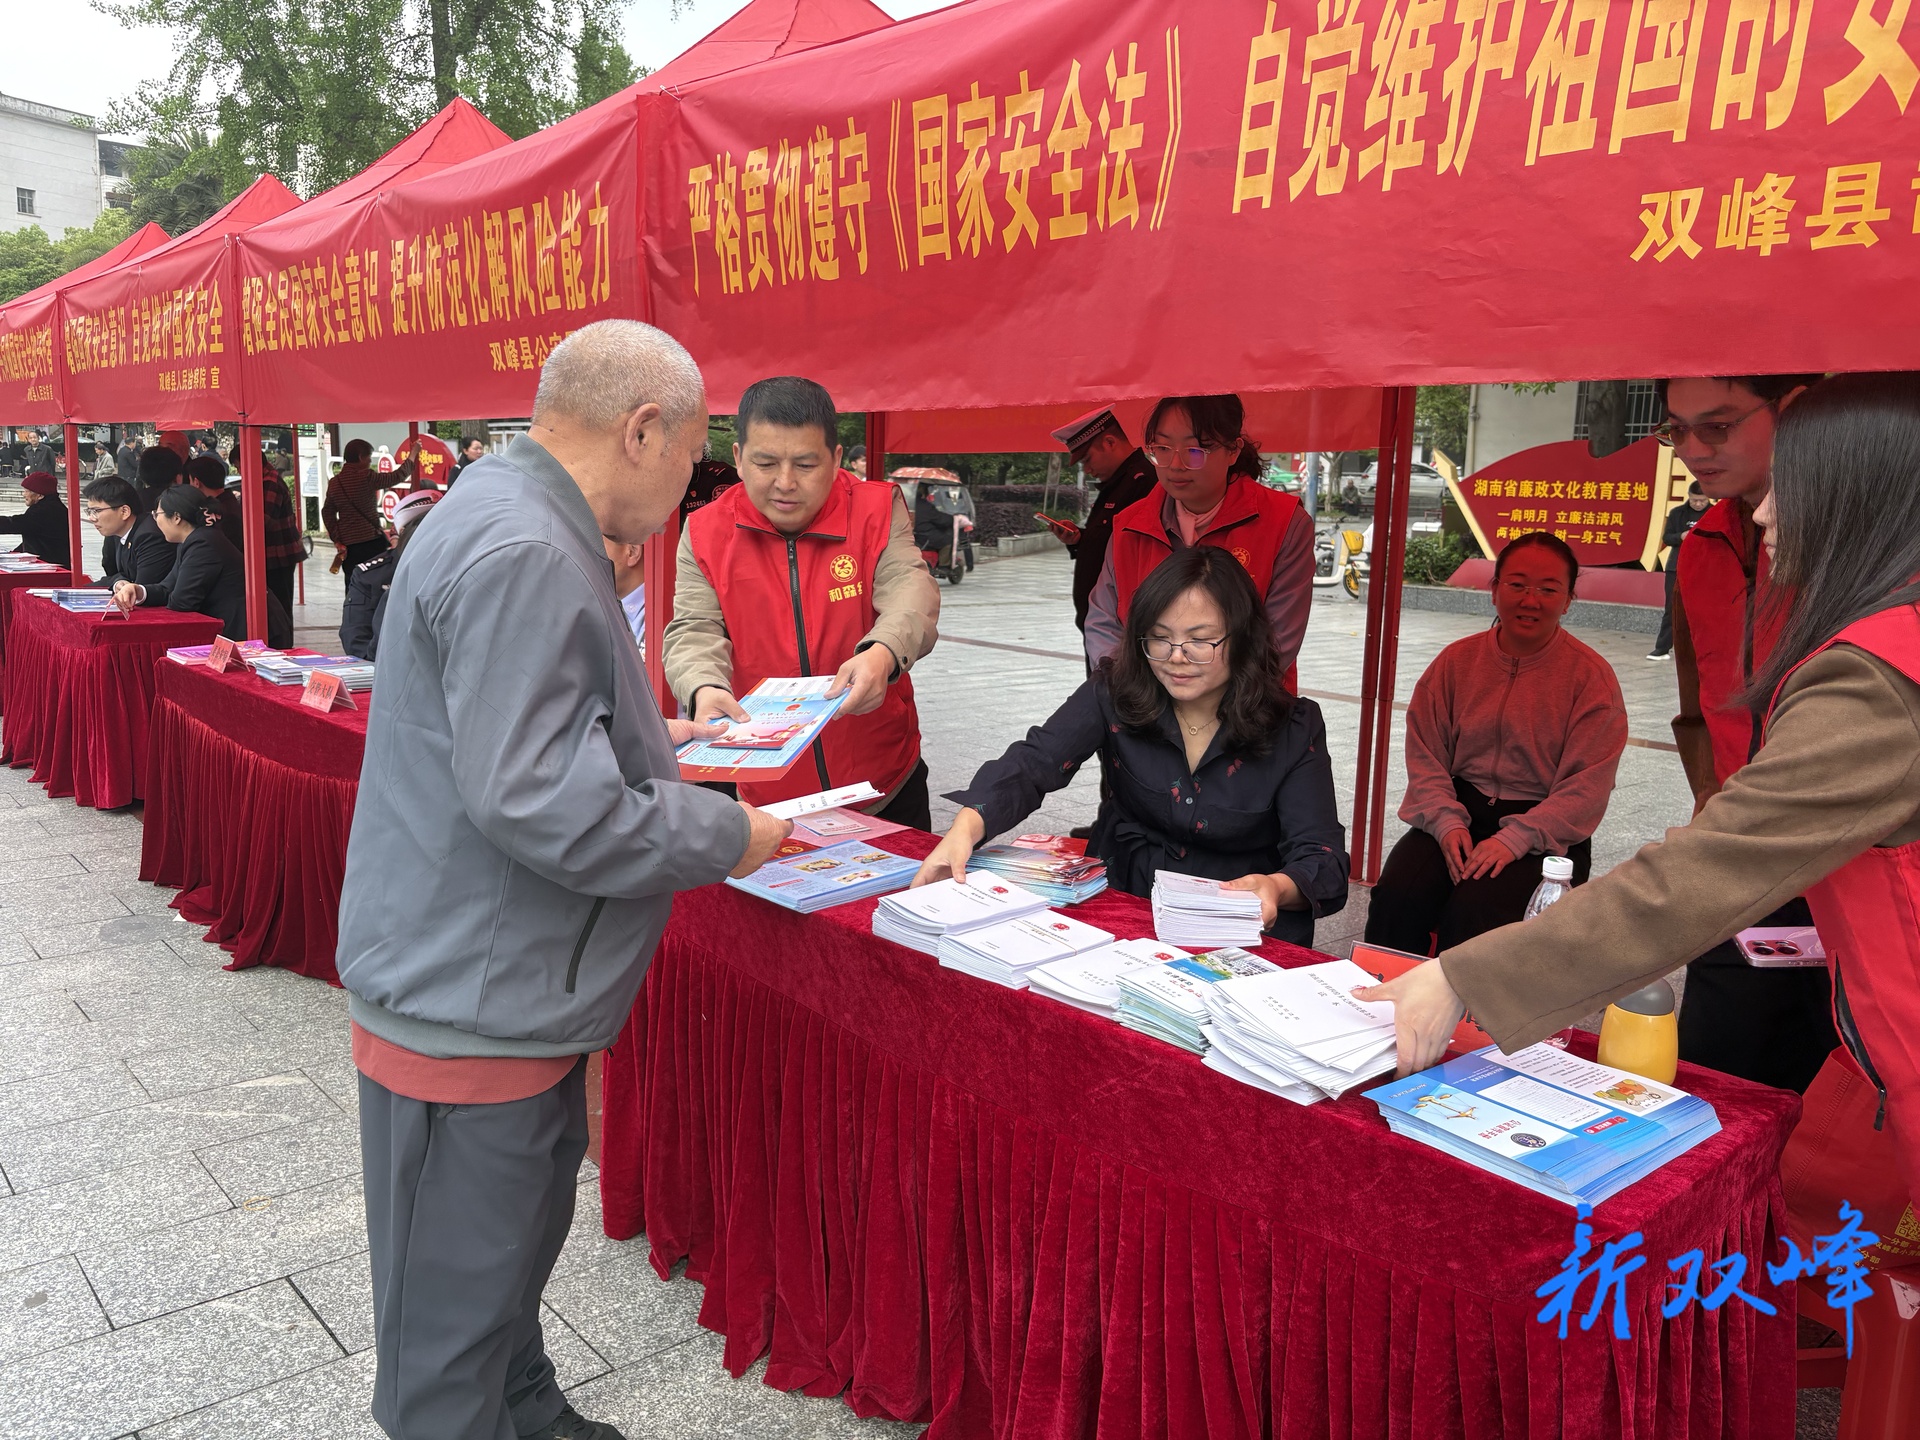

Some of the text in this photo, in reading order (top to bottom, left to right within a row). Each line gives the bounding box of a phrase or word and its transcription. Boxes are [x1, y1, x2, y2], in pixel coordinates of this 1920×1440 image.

[688, 24, 1182, 297] 严格贯彻遵守《国家安全法》
[1629, 160, 1920, 263] 双峰县
[242, 181, 611, 356] 增强全民国家安全意识 提升防范化解风险能力
[131, 278, 224, 366] 自觉维护国家安全
[488, 331, 577, 372] 双峰县公
[210, 365, 221, 390] 宣
[1474, 479, 1649, 501] 湖南省廉政文化教育基地
[1498, 509, 1624, 527] 一肩明月 立廉洁清风
